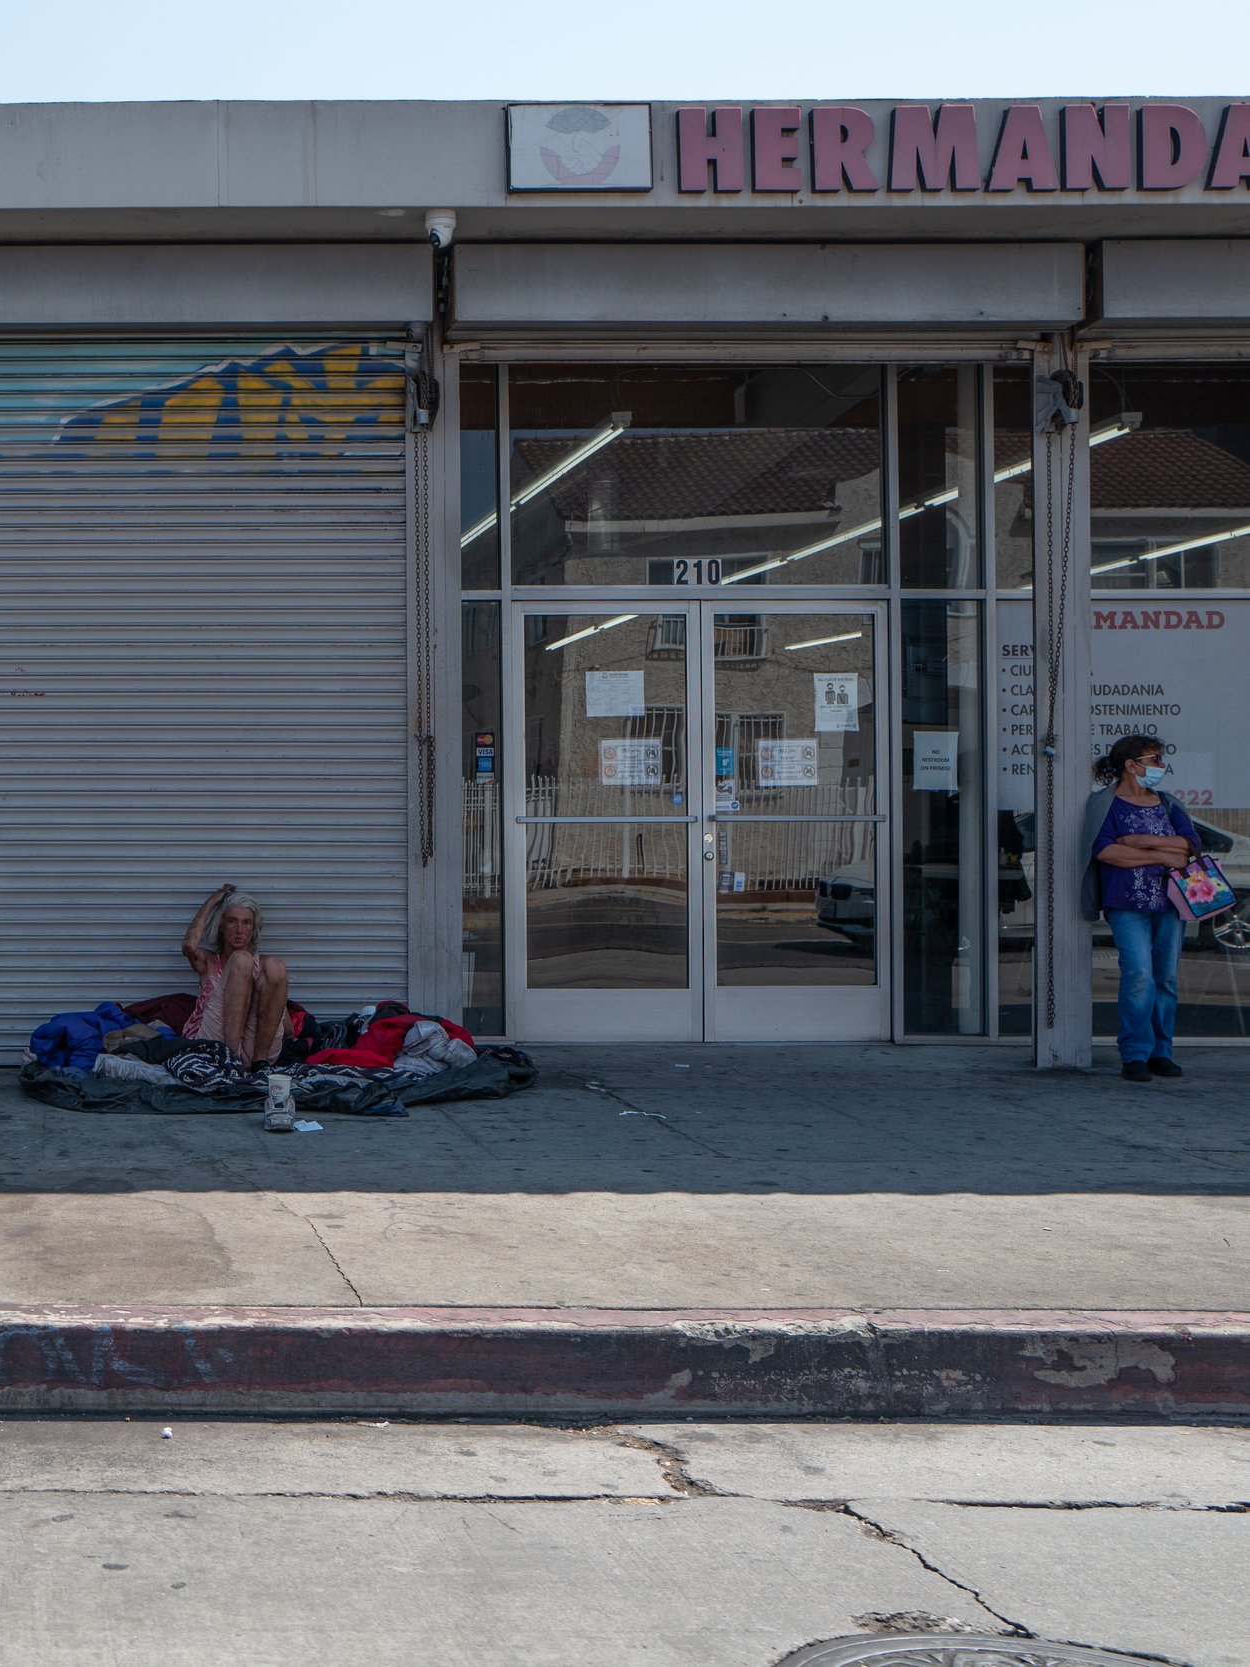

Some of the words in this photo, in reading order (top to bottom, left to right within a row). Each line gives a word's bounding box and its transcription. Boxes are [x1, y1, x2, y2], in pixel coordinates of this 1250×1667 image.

[674, 559, 720, 585] 210
[1090, 610, 1225, 630] MANDAD
[1010, 664, 1034, 677] CIU
[1010, 684, 1035, 696] CLA
[1090, 683, 1165, 697] IUDADANIA
[1010, 704, 1036, 716] CAR
[1090, 703, 1182, 717] STENIMIENTO
[1011, 724, 1034, 736] PER
[1099, 723, 1158, 737] TRABAJO
[1011, 743, 1035, 756] ACT
[1011, 763, 1036, 776] REN
[1173, 789, 1214, 806] 222
